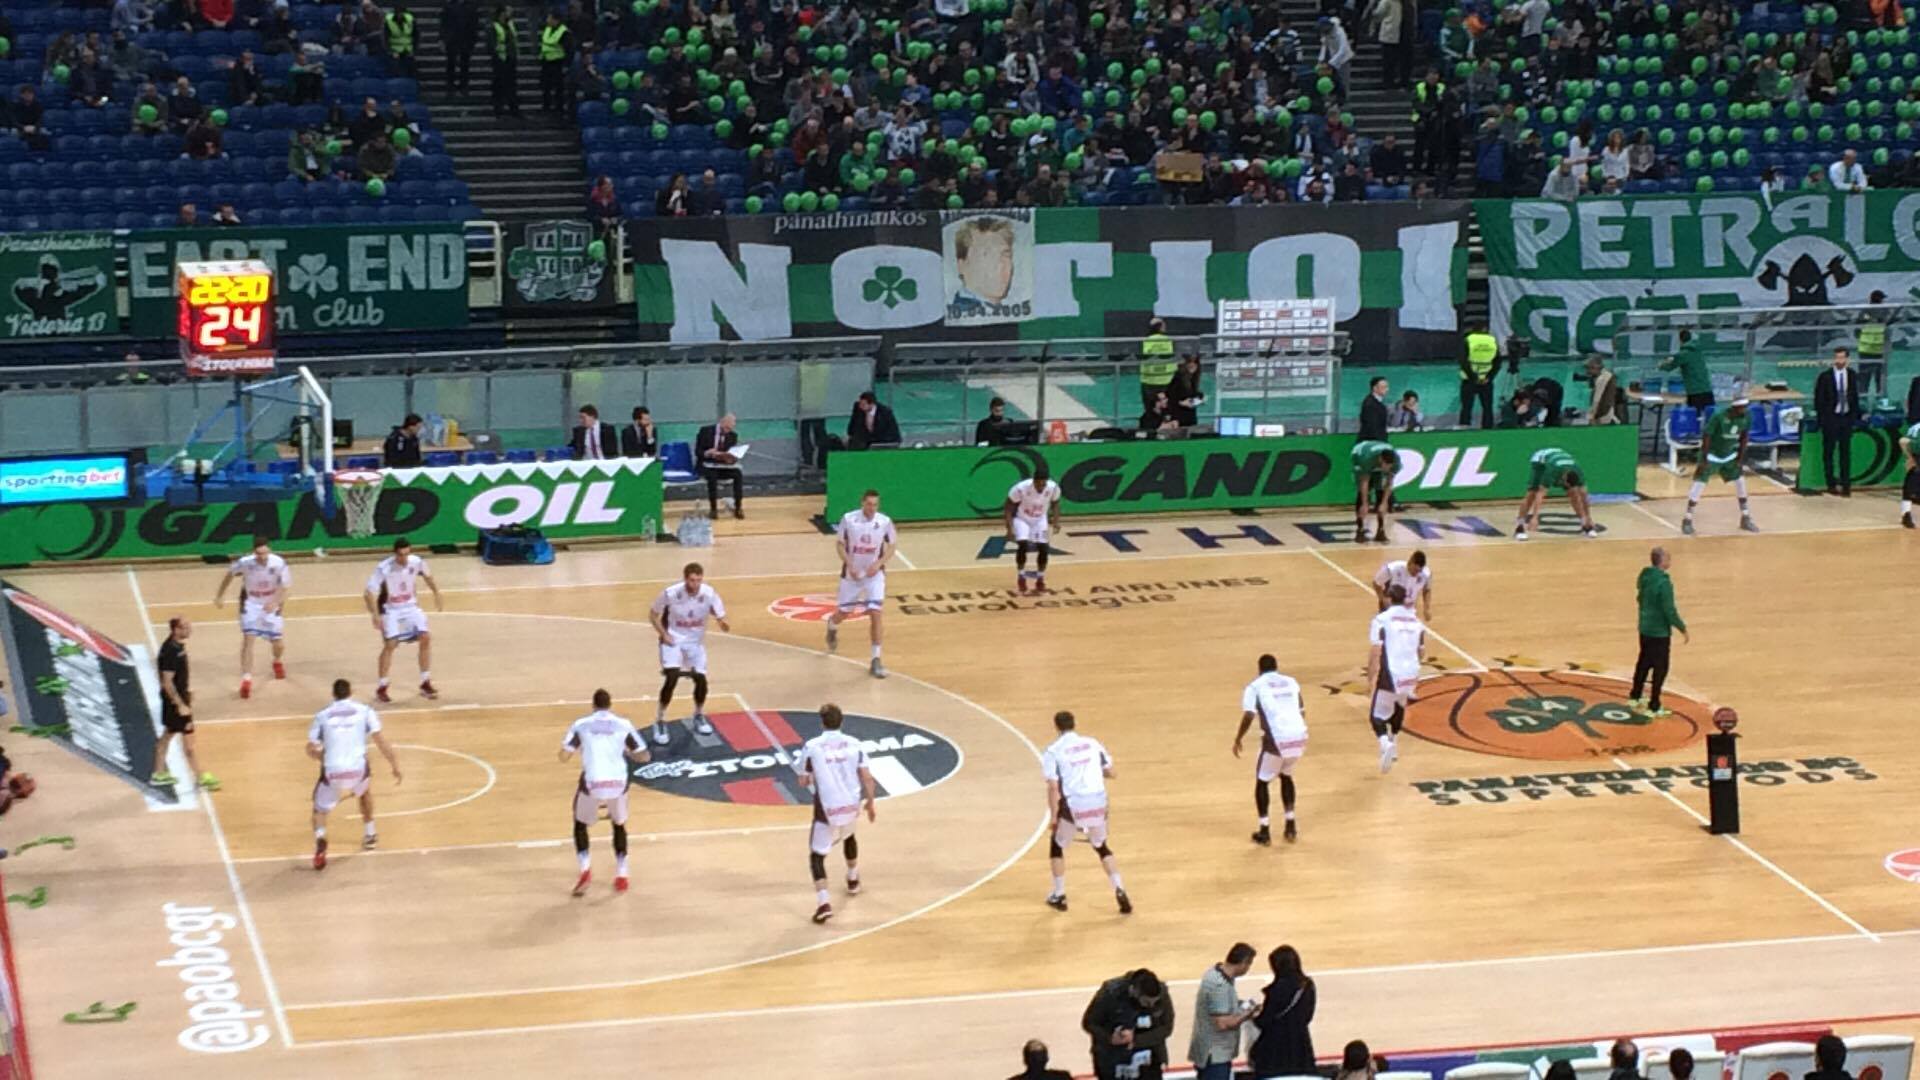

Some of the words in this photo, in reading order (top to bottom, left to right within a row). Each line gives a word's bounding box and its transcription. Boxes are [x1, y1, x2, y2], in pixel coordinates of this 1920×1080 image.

[348, 233, 465, 293] END
[200, 306, 261, 346] 24
[313, 297, 385, 327] club
[4, 470, 120, 488] sportingbet
[1058, 449, 1331, 501] GAND
[463, 480, 626, 529] OIL
[899, 591, 1177, 616] EuroLeague
[1089, 575, 1271, 598] AIRLINES
[157, 902, 271, 1054] @paobcgr
